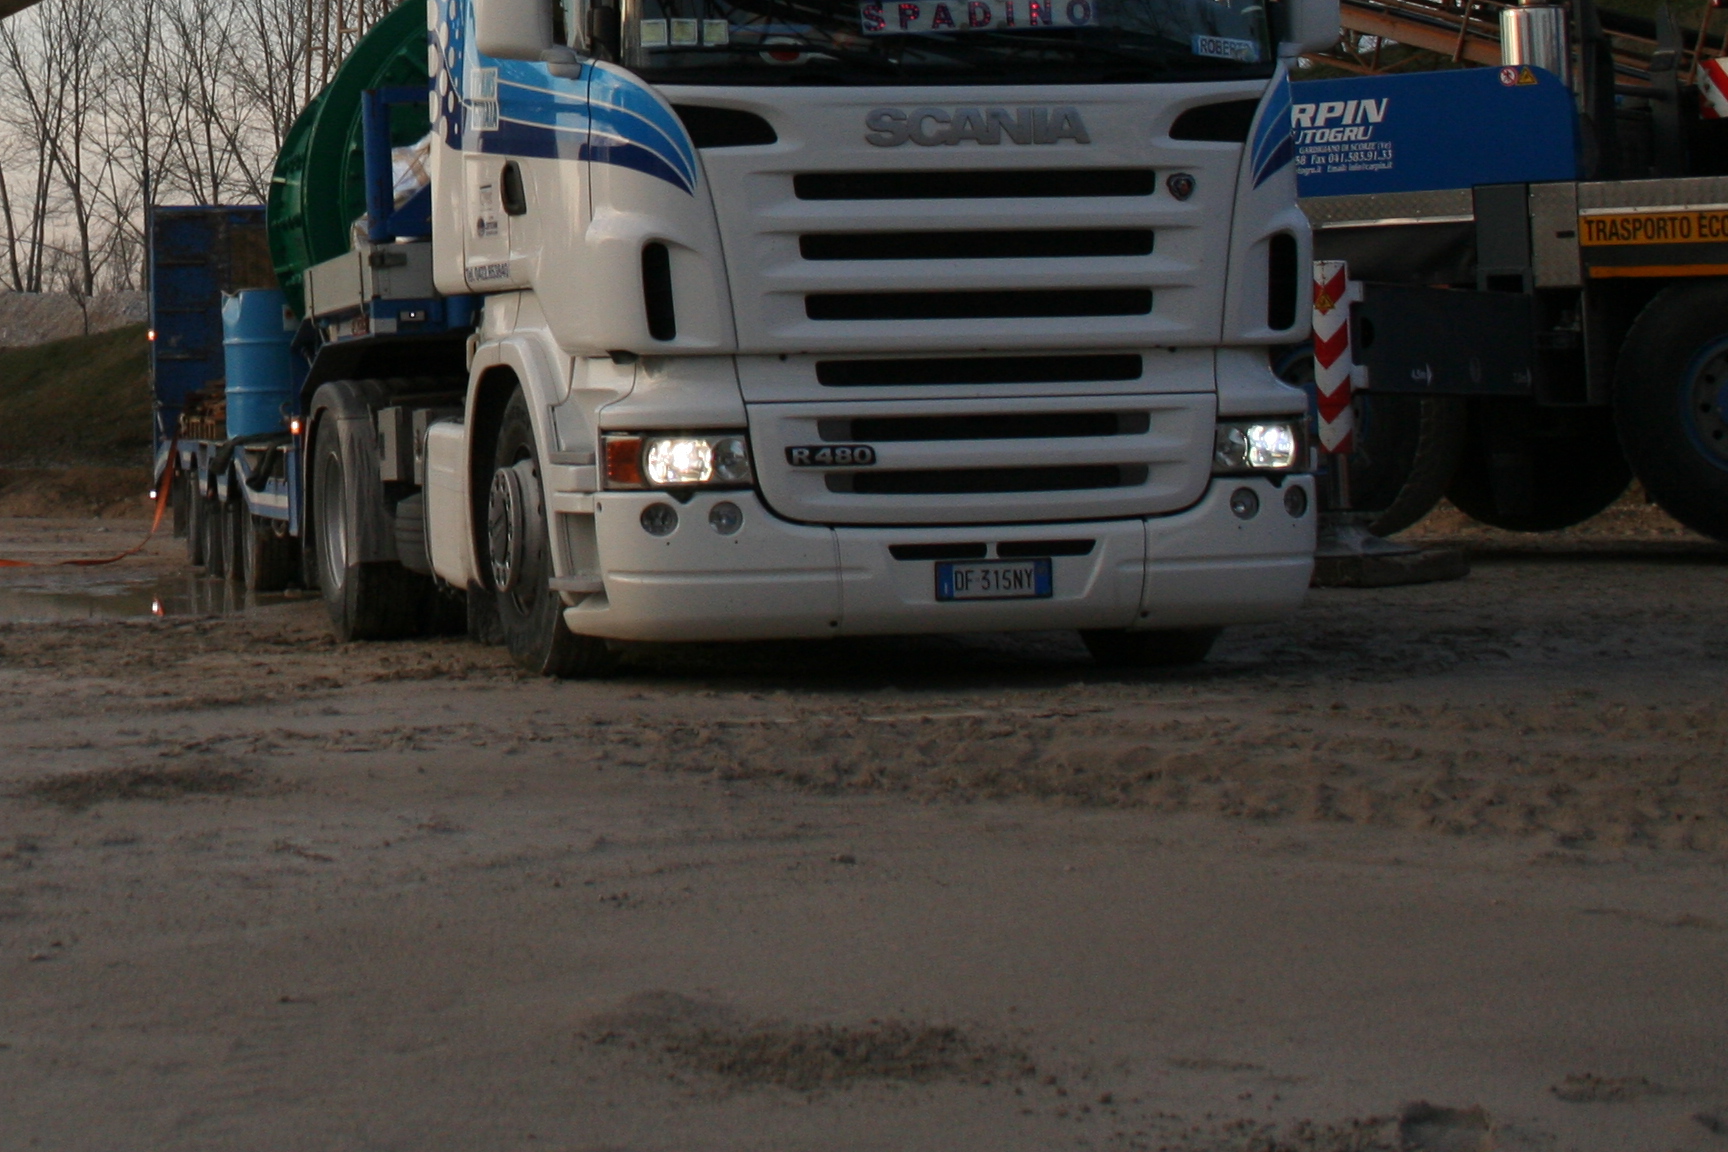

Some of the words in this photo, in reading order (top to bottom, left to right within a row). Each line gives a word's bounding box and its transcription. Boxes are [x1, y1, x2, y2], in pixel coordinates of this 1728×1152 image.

[863, 0, 1091, 31] SPADINO
[1291, 97, 1389, 128] RPIN
[865, 107, 1091, 147] SCANIA
[1311, 154, 1326, 164] Fax
[1584, 216, 1691, 241] TRASPORTO
[792, 448, 812, 465] R
[815, 447, 873, 464] 480
